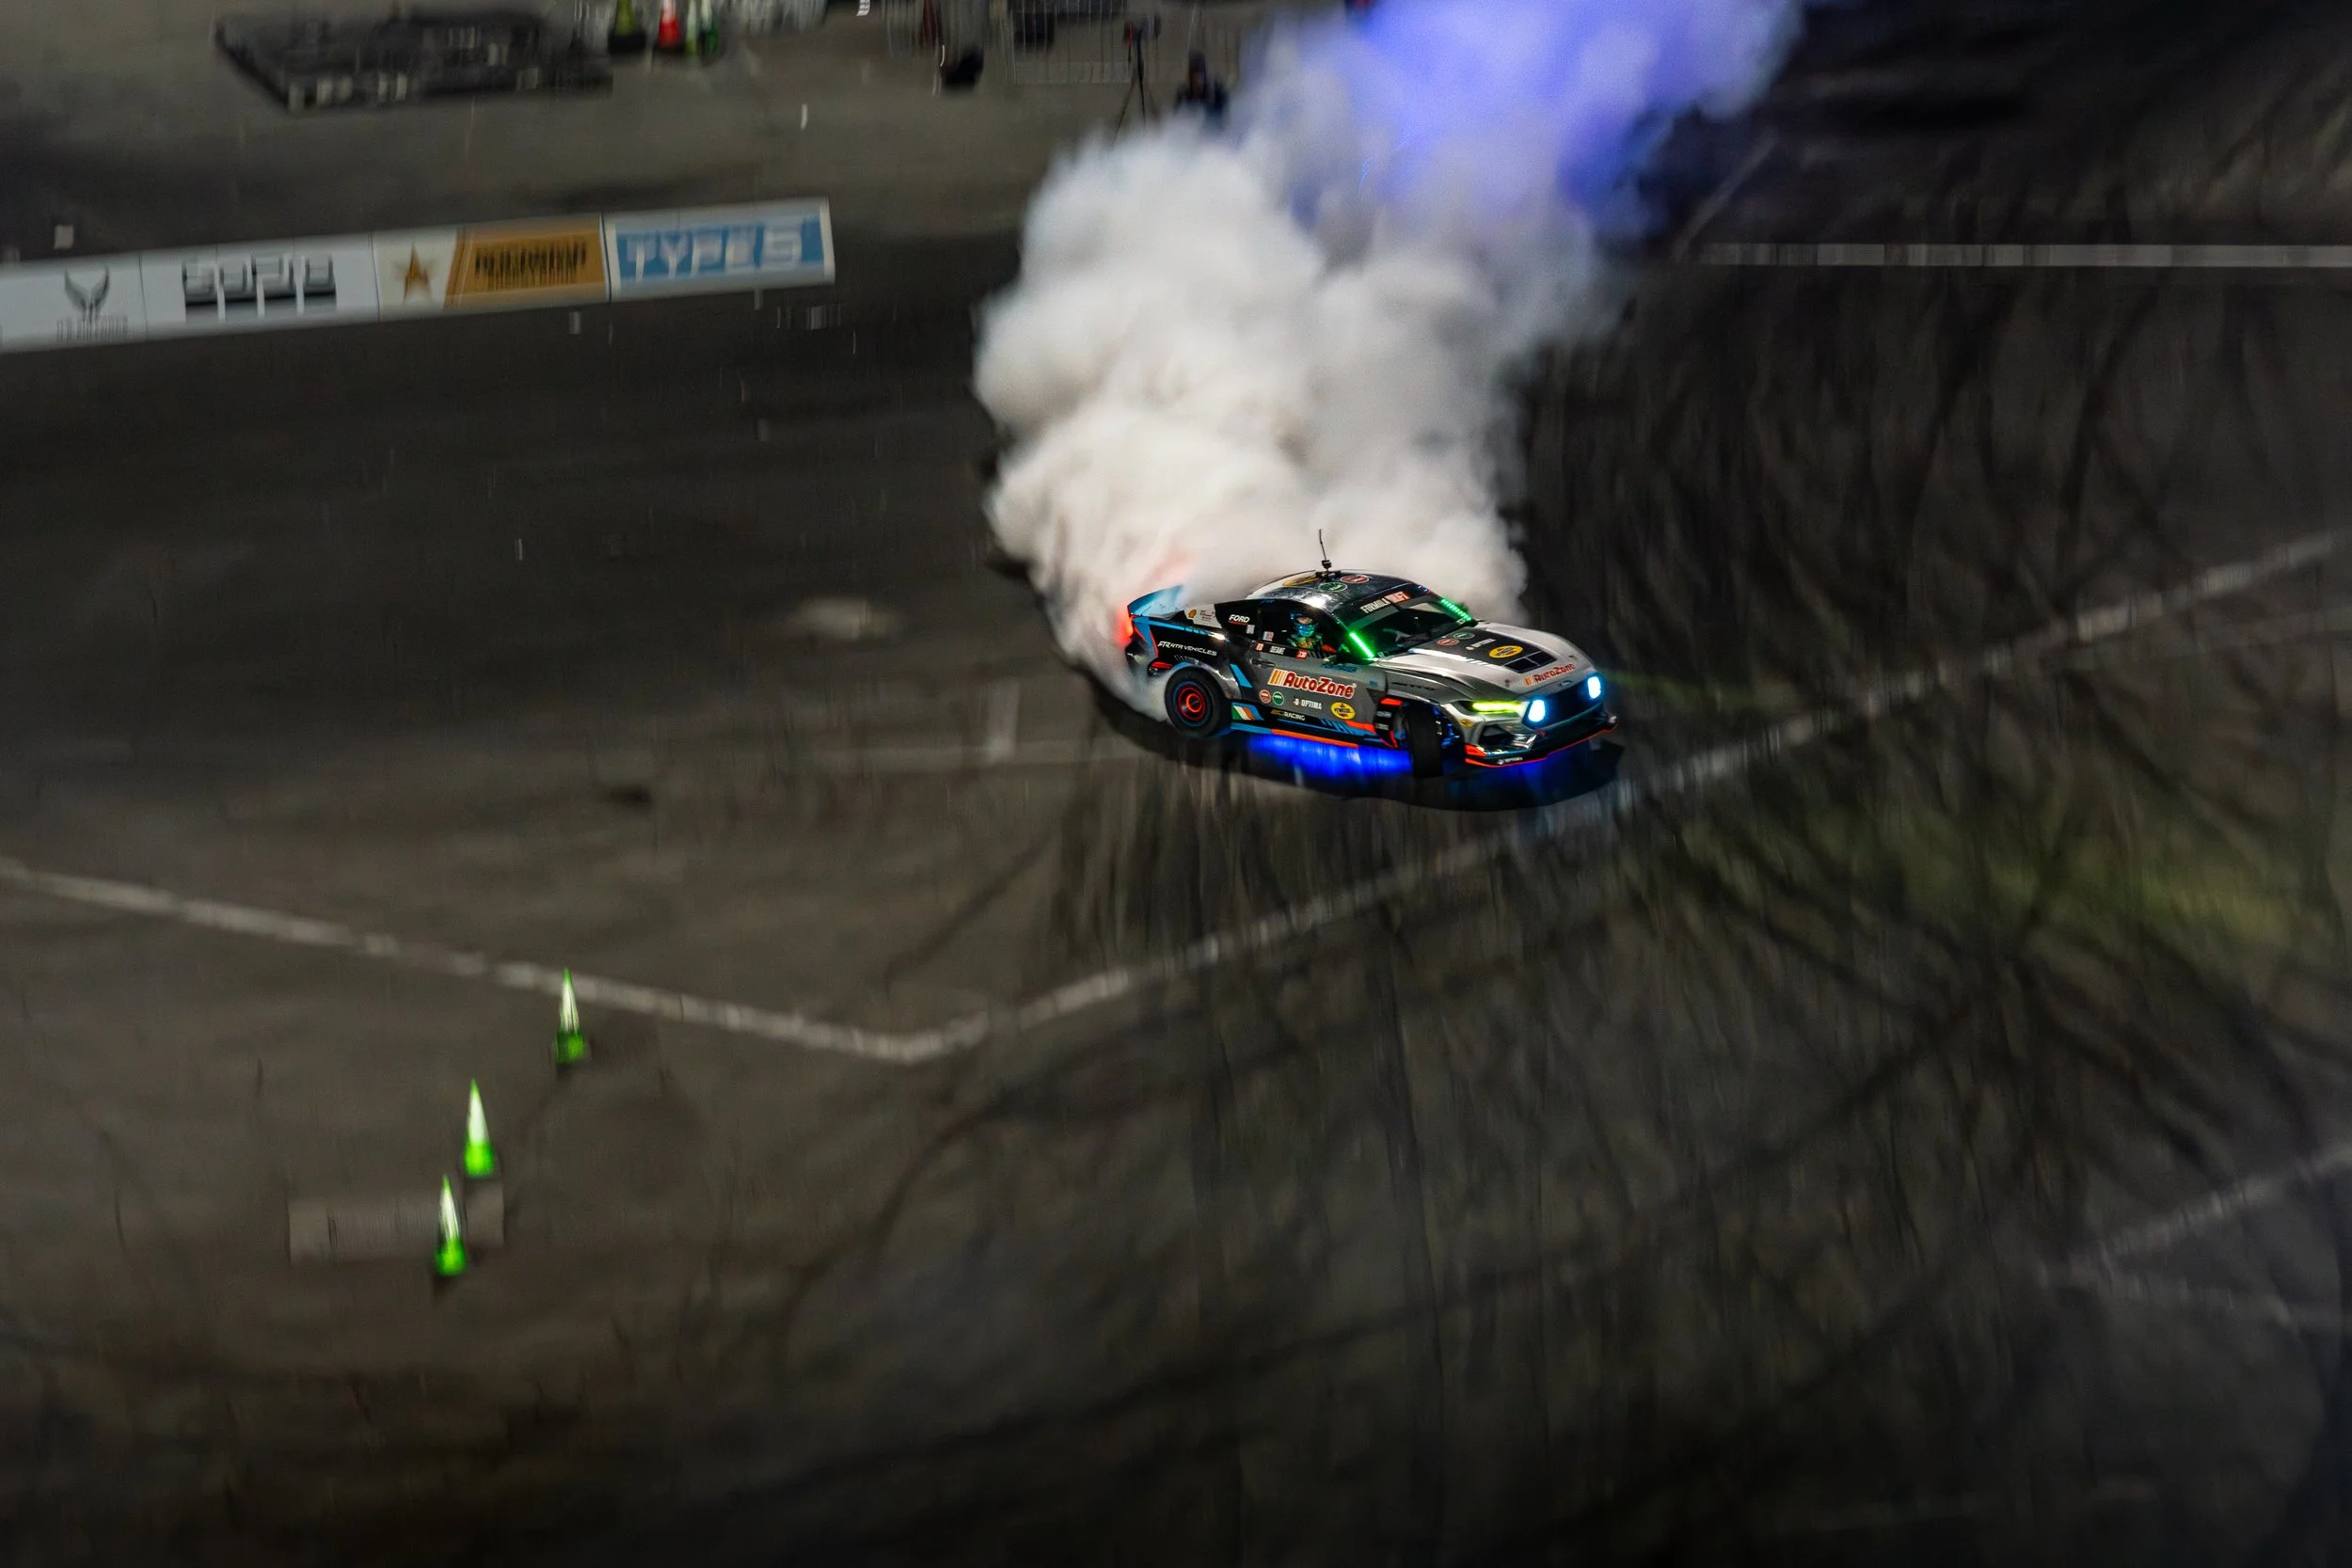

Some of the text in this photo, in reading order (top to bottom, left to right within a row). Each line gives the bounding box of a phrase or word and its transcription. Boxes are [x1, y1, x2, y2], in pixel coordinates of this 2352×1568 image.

[1229, 613, 1250, 623] FORD
[1184, 645, 1217, 657] VEHICLES
[1283, 672, 1355, 699] AutoZone
[1300, 699, 1322, 710] OPTIMA
